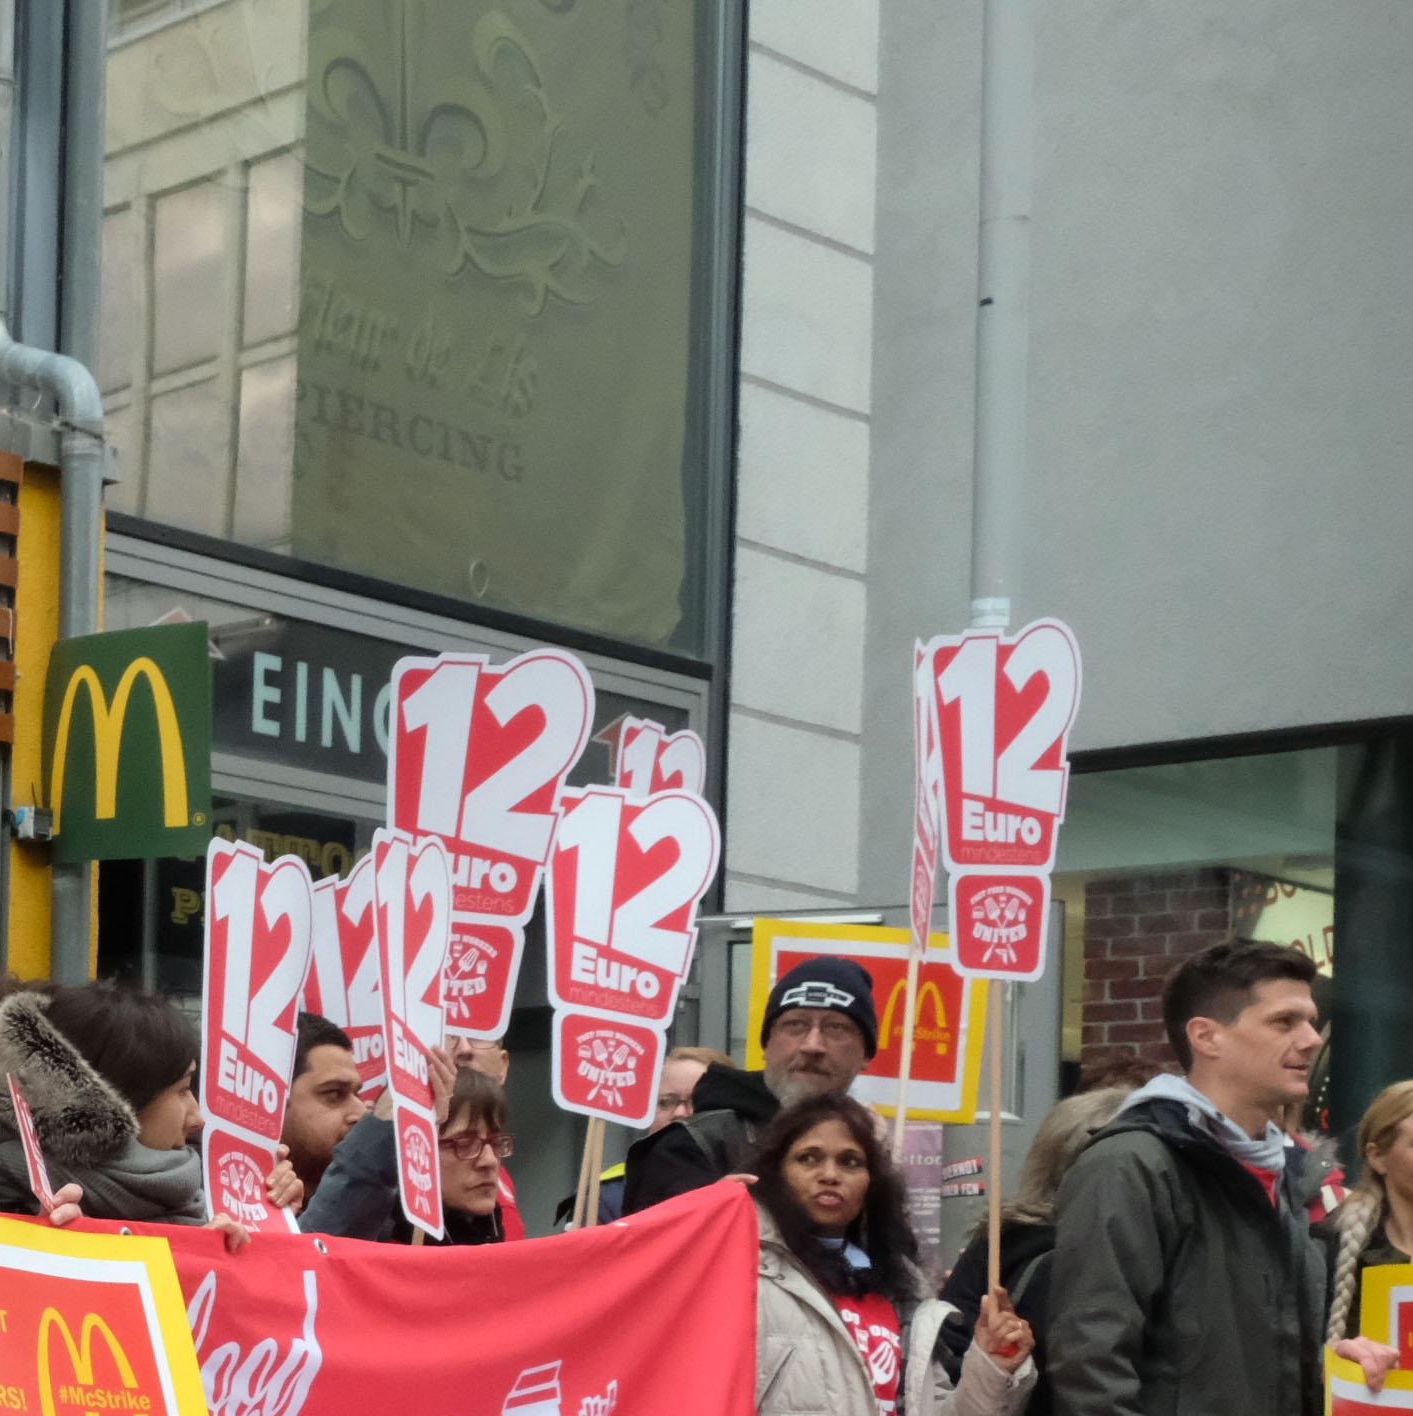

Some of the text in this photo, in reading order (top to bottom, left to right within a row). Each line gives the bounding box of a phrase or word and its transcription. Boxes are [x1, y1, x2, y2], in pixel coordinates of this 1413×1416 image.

[251, 649, 390, 762] EIN
[939, 624, 1077, 814] 12
[402, 653, 589, 863] 12
[961, 798, 1042, 846] Euro
[452, 852, 518, 894] uro
[557, 793, 716, 978] 12
[213, 850, 310, 1081] 12
[376, 838, 448, 1058] 12
[973, 921, 1027, 944] UNITED
[570, 940, 661, 999] Euro
[217, 1037, 279, 1114] Euro
[392, 1018, 430, 1086] Euro
[577, 1060, 637, 1087] UNITED
[222, 1188, 269, 1221] UNITED
[59, 1383, 152, 1412] #McStrike
